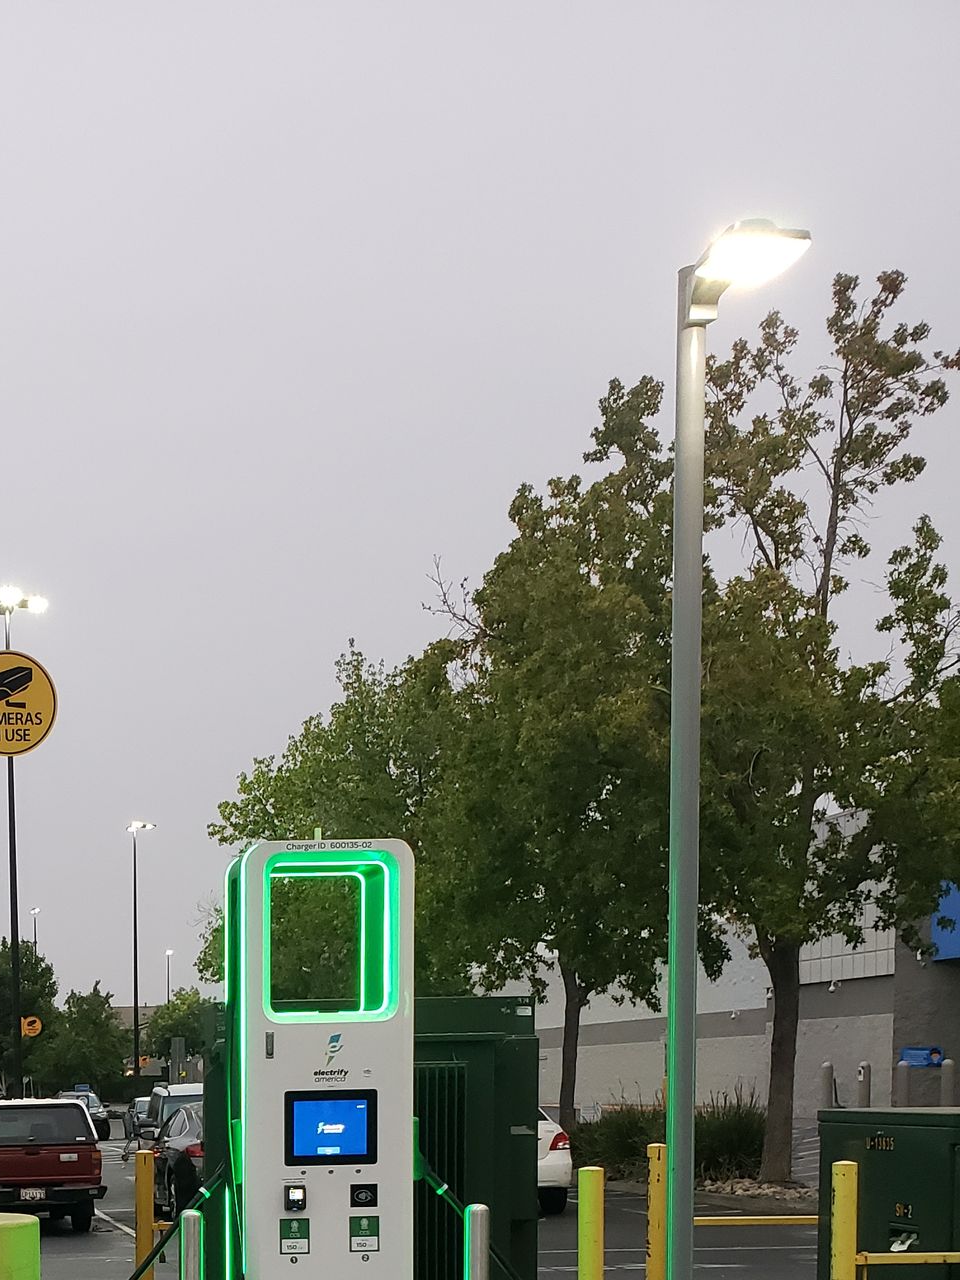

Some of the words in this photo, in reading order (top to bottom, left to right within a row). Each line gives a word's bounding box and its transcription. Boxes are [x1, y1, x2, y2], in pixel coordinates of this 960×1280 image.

[5, 728, 31, 742] USE
[286, 843, 316, 852] Charger
[317, 842, 327, 850] ID
[330, 841, 373, 849] 600135-02
[313, 1069, 349, 1077] electrify
